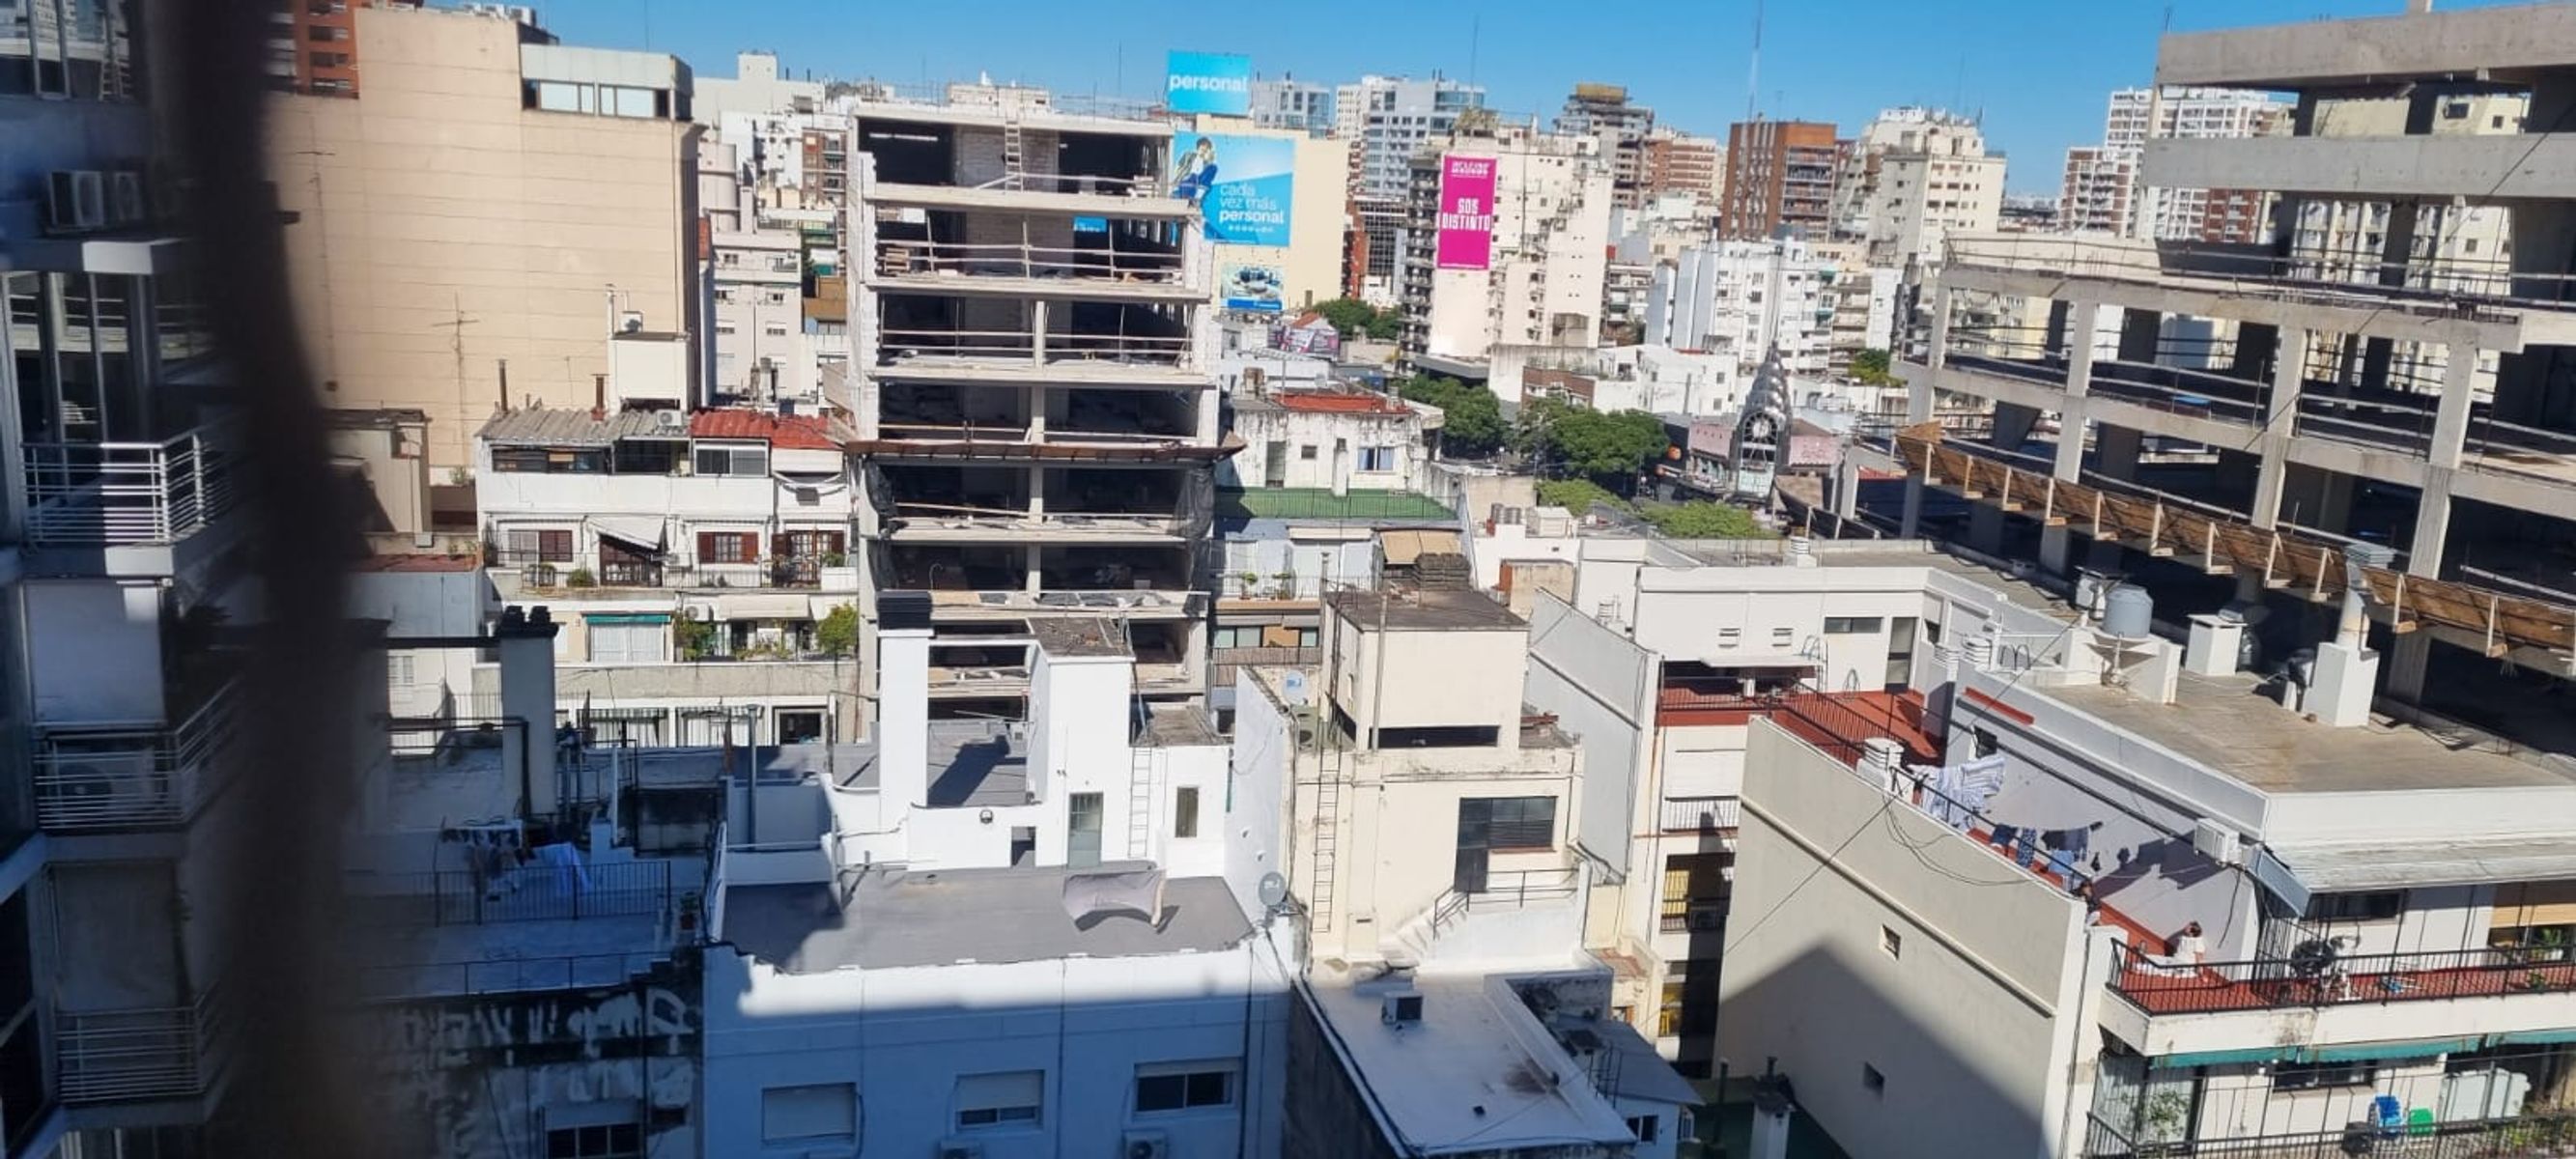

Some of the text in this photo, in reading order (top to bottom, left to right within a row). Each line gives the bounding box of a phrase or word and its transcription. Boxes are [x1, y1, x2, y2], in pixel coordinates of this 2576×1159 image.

[1170, 74, 1247, 91] personal
[1220, 182, 1256, 197] cada
[1220, 197, 1245, 210] vez
[1458, 197, 1479, 213] SOS
[1219, 210, 1284, 224] personal
[1442, 212, 1490, 231] DISTINTO
